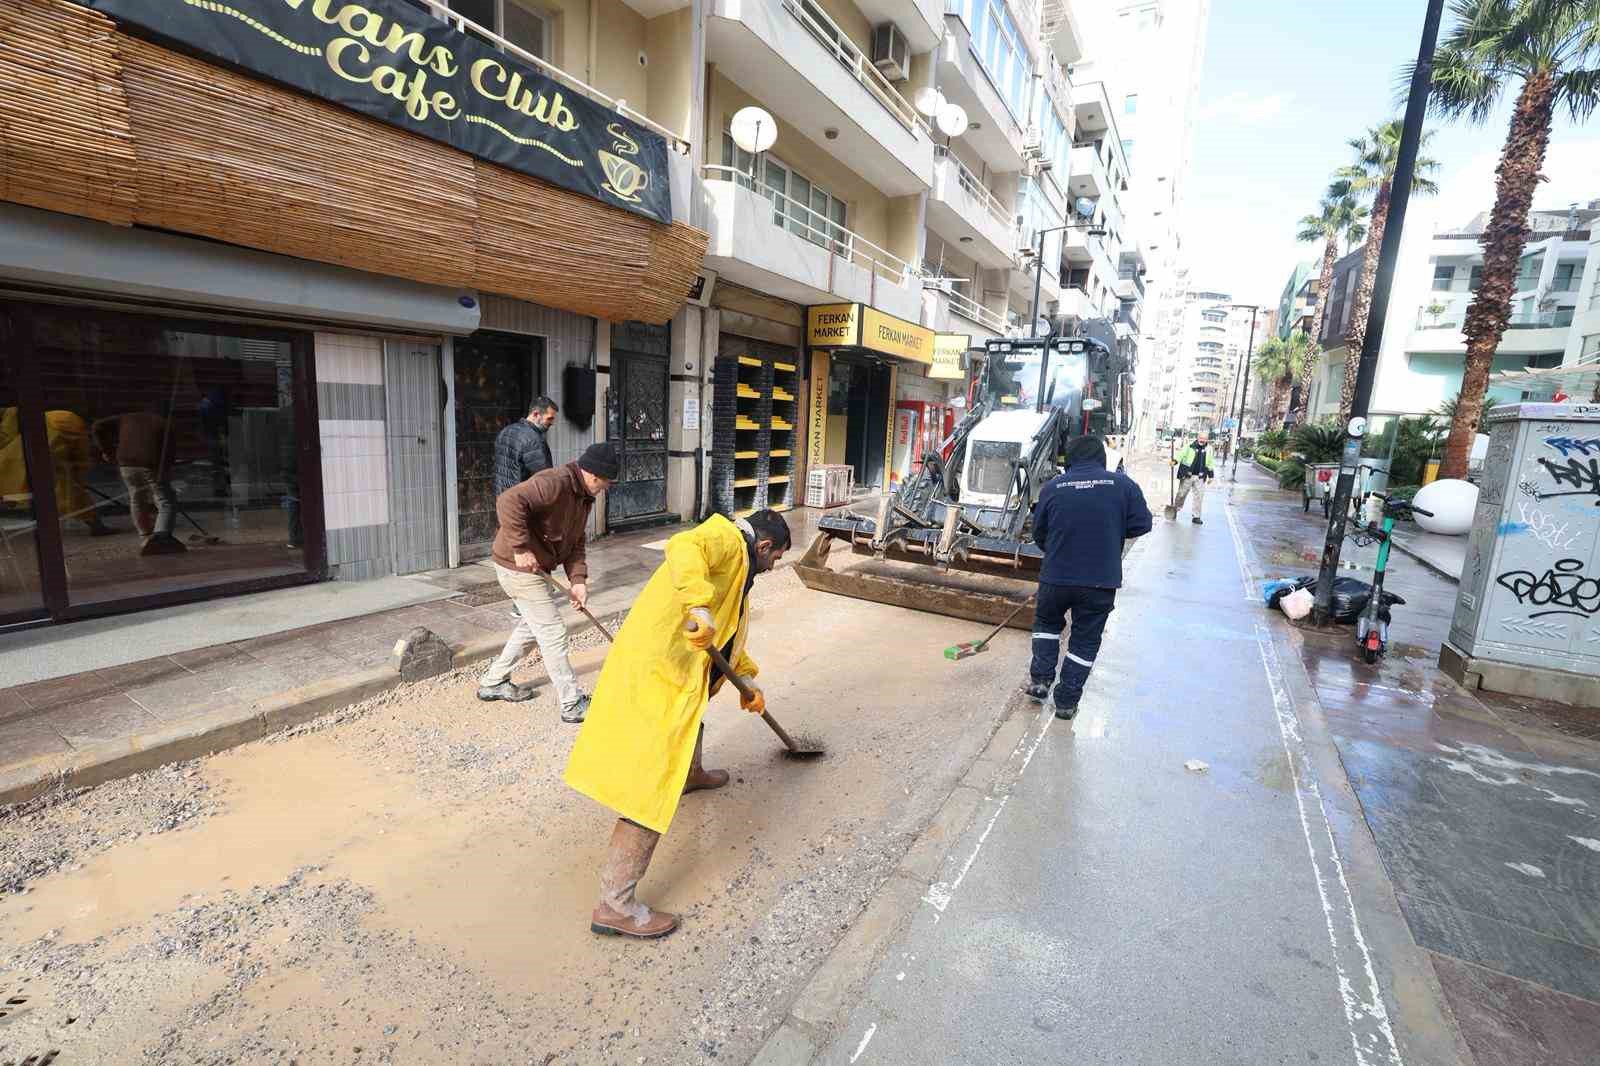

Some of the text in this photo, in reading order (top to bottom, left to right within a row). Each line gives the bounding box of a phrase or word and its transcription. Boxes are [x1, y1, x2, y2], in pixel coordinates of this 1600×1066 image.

[326, 37, 462, 121] Cafe
[470, 58, 580, 132] Club
[813, 326, 851, 338] MARKET
[817, 311, 854, 325] FERKAN
[878, 324, 922, 351] FERKAN MARKET
[815, 376, 824, 429] MARKET
